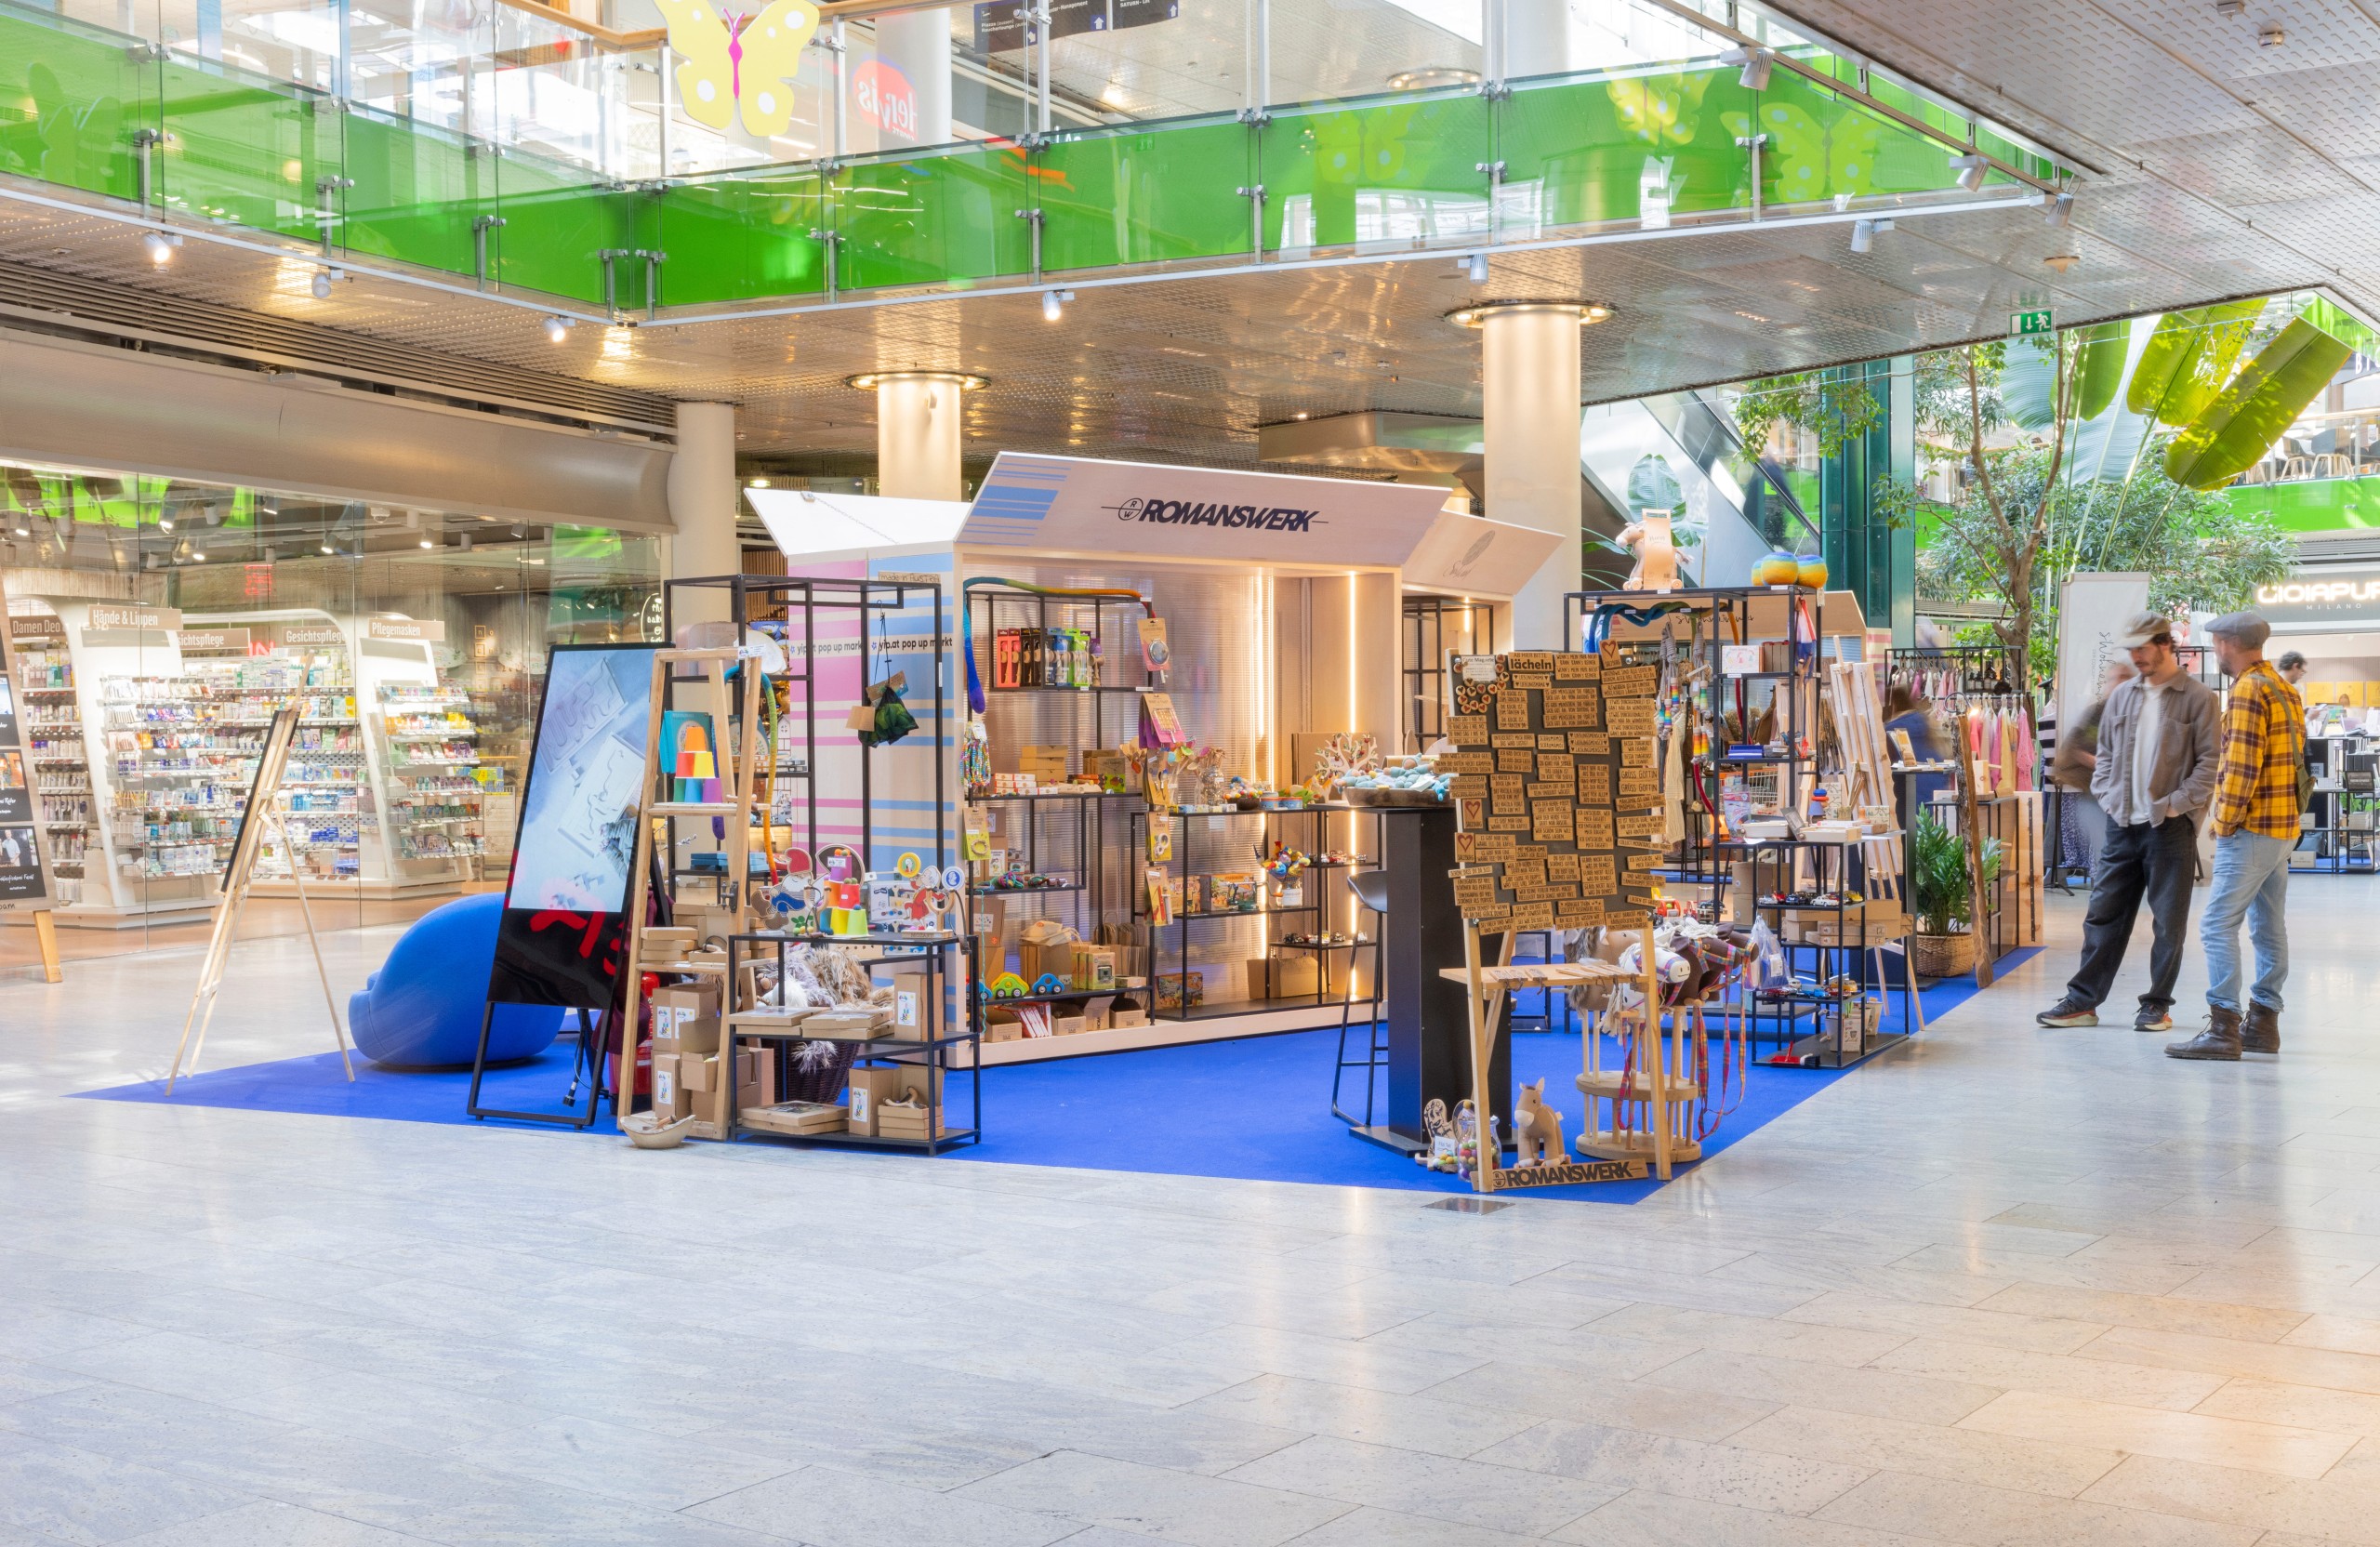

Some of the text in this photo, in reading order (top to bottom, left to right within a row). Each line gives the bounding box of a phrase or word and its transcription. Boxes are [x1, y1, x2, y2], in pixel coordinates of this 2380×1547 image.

[1139, 499, 1320, 532] ROMANSWERK
[93, 609, 158, 627] Hände & Lippen
[12, 621, 43, 634] Damen
[372, 622, 421, 637] Pflegemasken
[178, 634, 224, 647] sichtspflege
[902, 640, 916, 650] pop
[919, 640, 928, 649] up
[930, 637, 952, 647] mrkt
[819, 644, 832, 654] pop
[833, 644, 843, 653] up
[844, 641, 861, 651] mark
[1510, 659, 1552, 670] lächeln
[1506, 1162, 1635, 1187] ROMANSWERK
